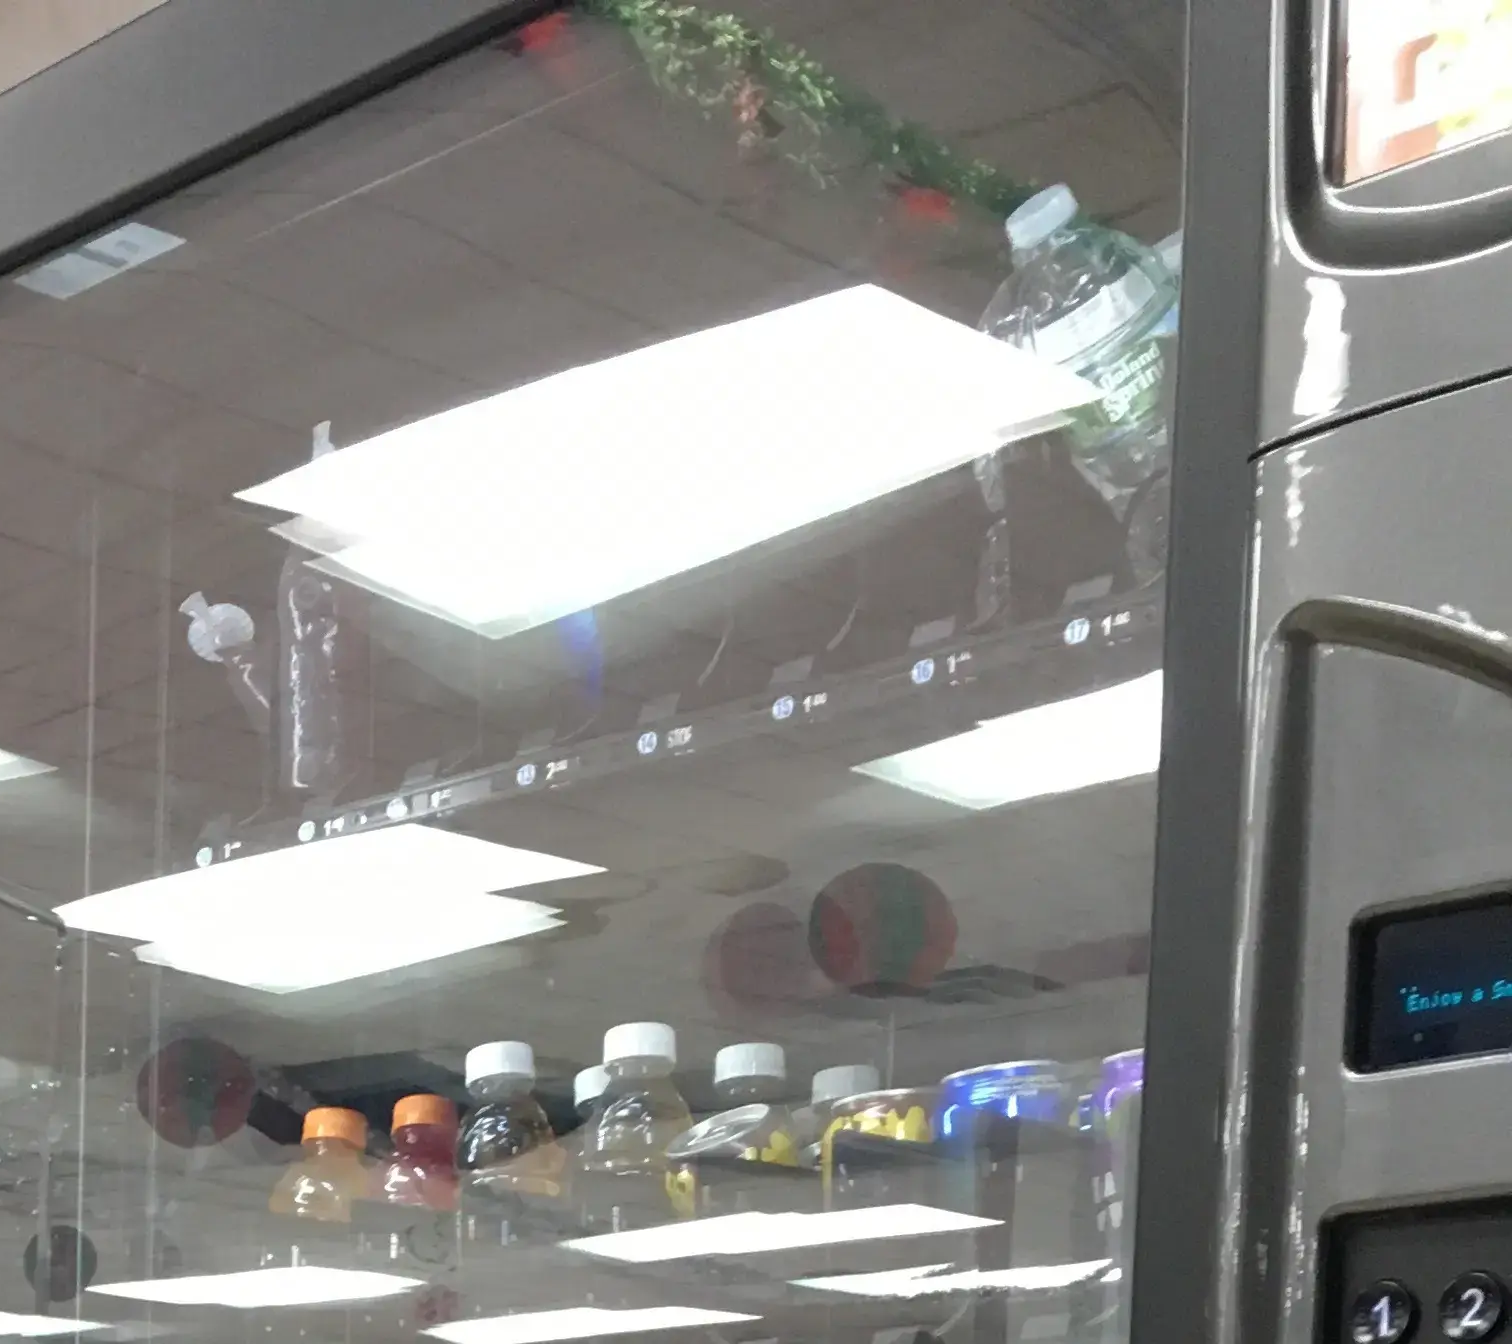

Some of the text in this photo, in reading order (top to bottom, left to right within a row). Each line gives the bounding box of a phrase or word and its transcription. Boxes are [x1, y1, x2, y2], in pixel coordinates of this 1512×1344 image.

[1098, 340, 1161, 389] Poland
[1372, 1287, 1485, 1338] 1 2
